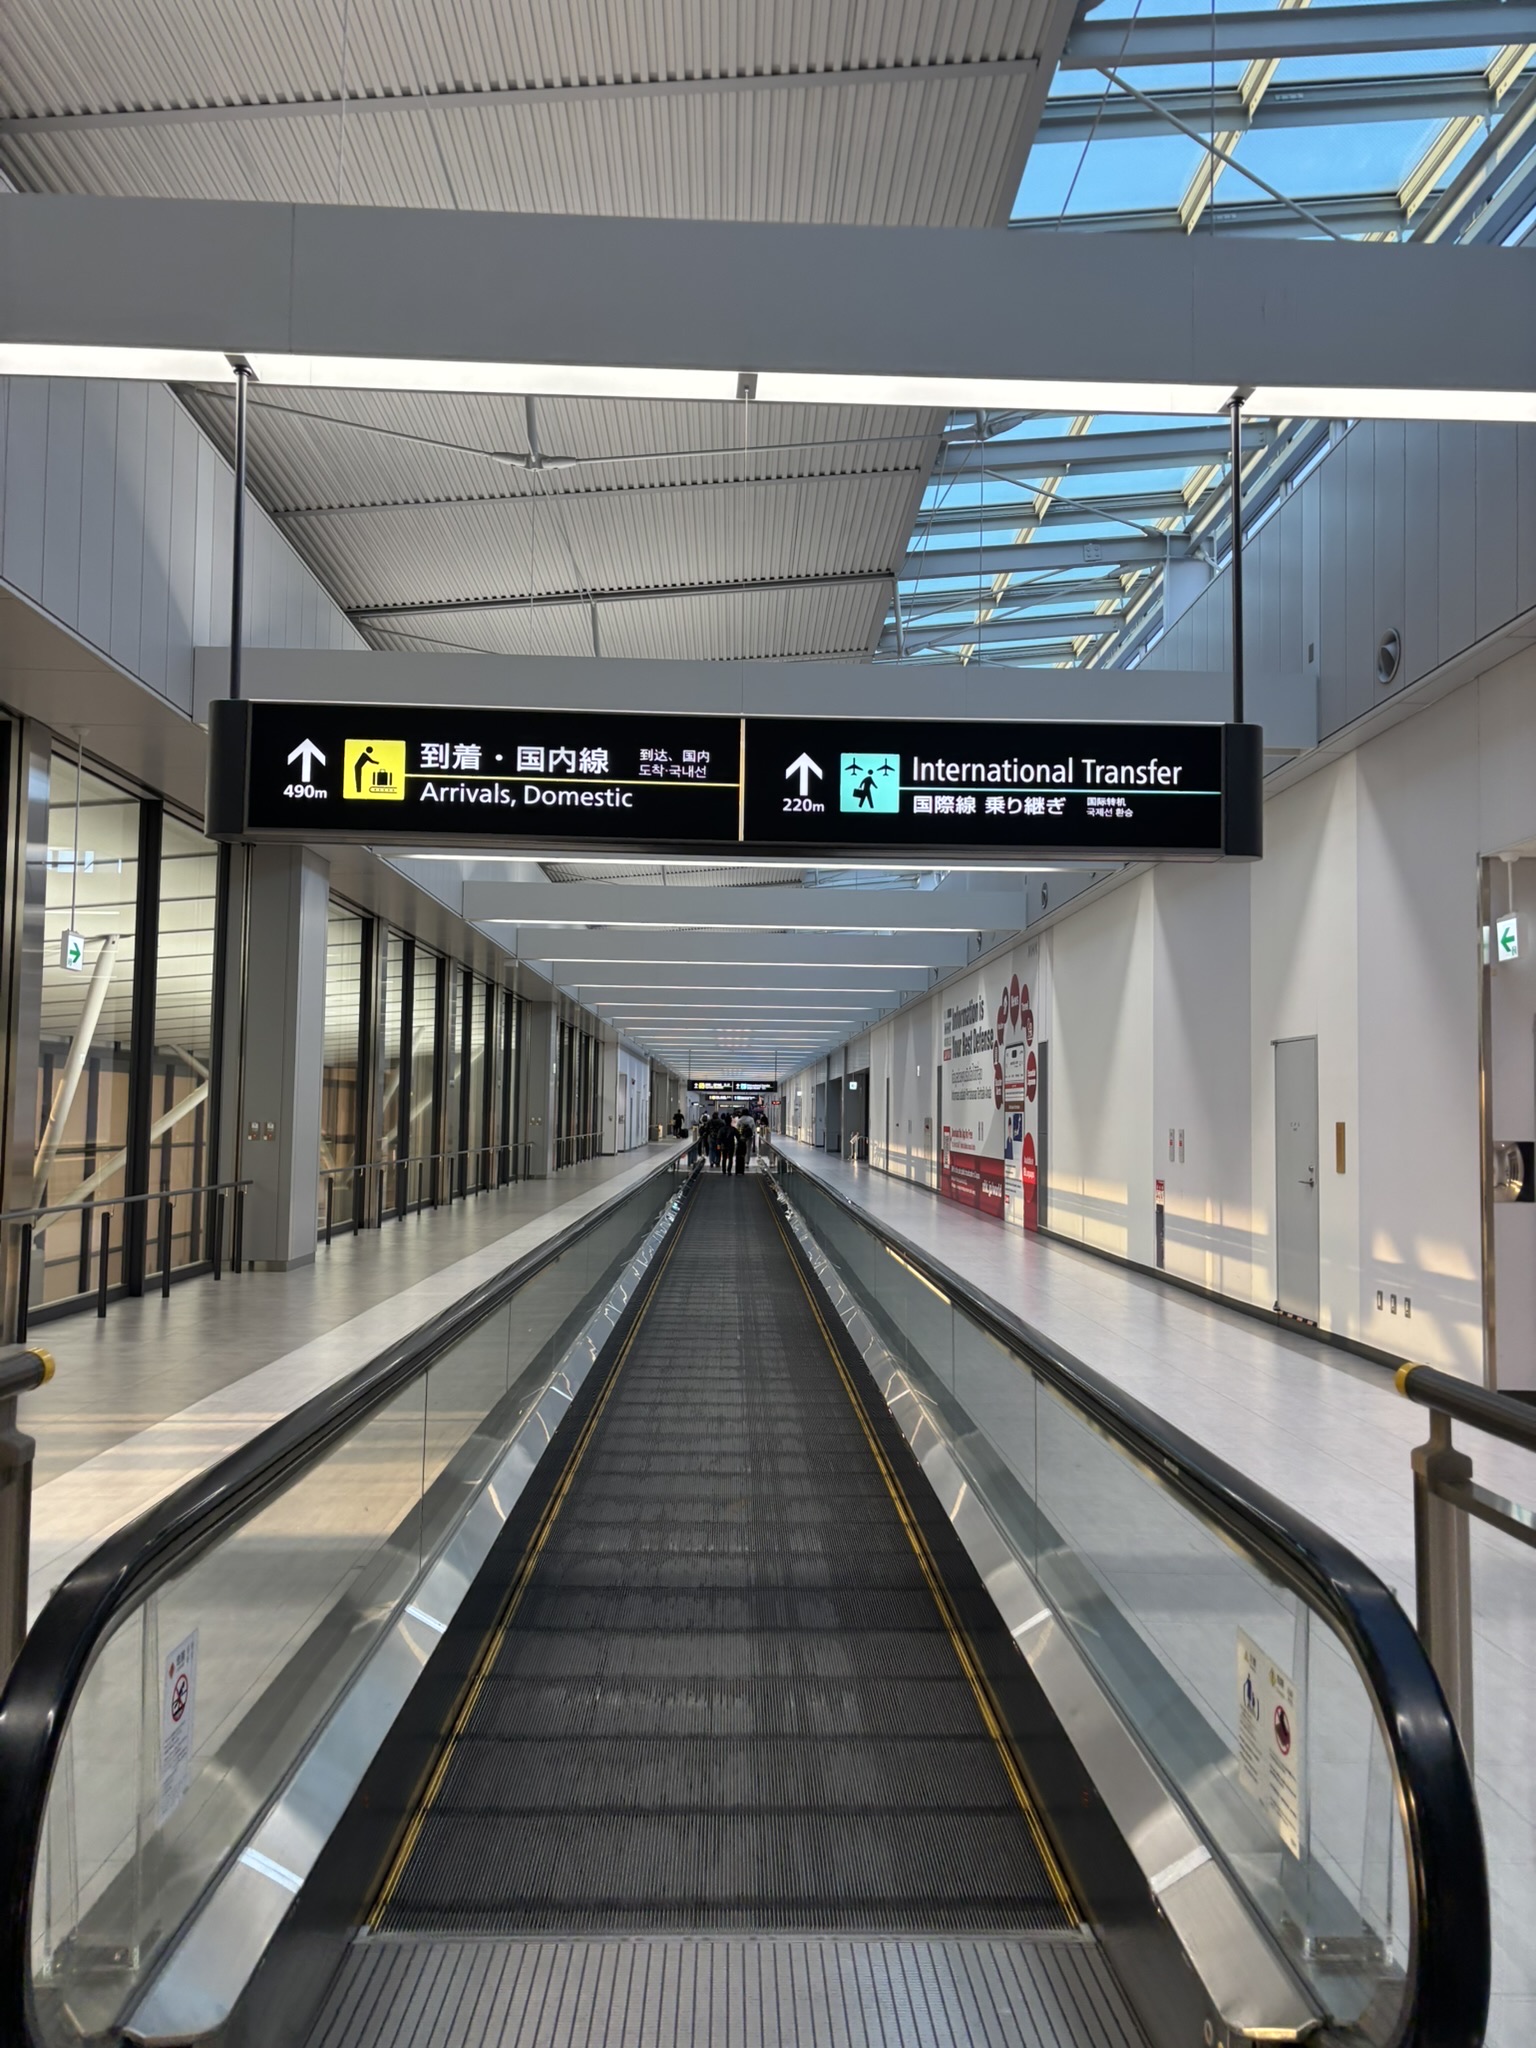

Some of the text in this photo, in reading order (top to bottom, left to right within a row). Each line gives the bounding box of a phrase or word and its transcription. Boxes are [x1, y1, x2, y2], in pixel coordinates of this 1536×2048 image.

[419, 742, 609, 775] 到着・国内線
[912, 756, 1183, 788] International Transfer
[282, 784, 328, 800] 490m
[419, 781, 633, 808] Arrivals, Domestic
[782, 797, 825, 813] 220m
[913, 795, 1067, 816] 国際線 乗り継ぎ
[1086, 796, 1127, 807] 国际转机
[952, 998, 979, 1031] Information
[962, 1028, 973, 1057] Best
[973, 1025, 994, 1054] Defense
